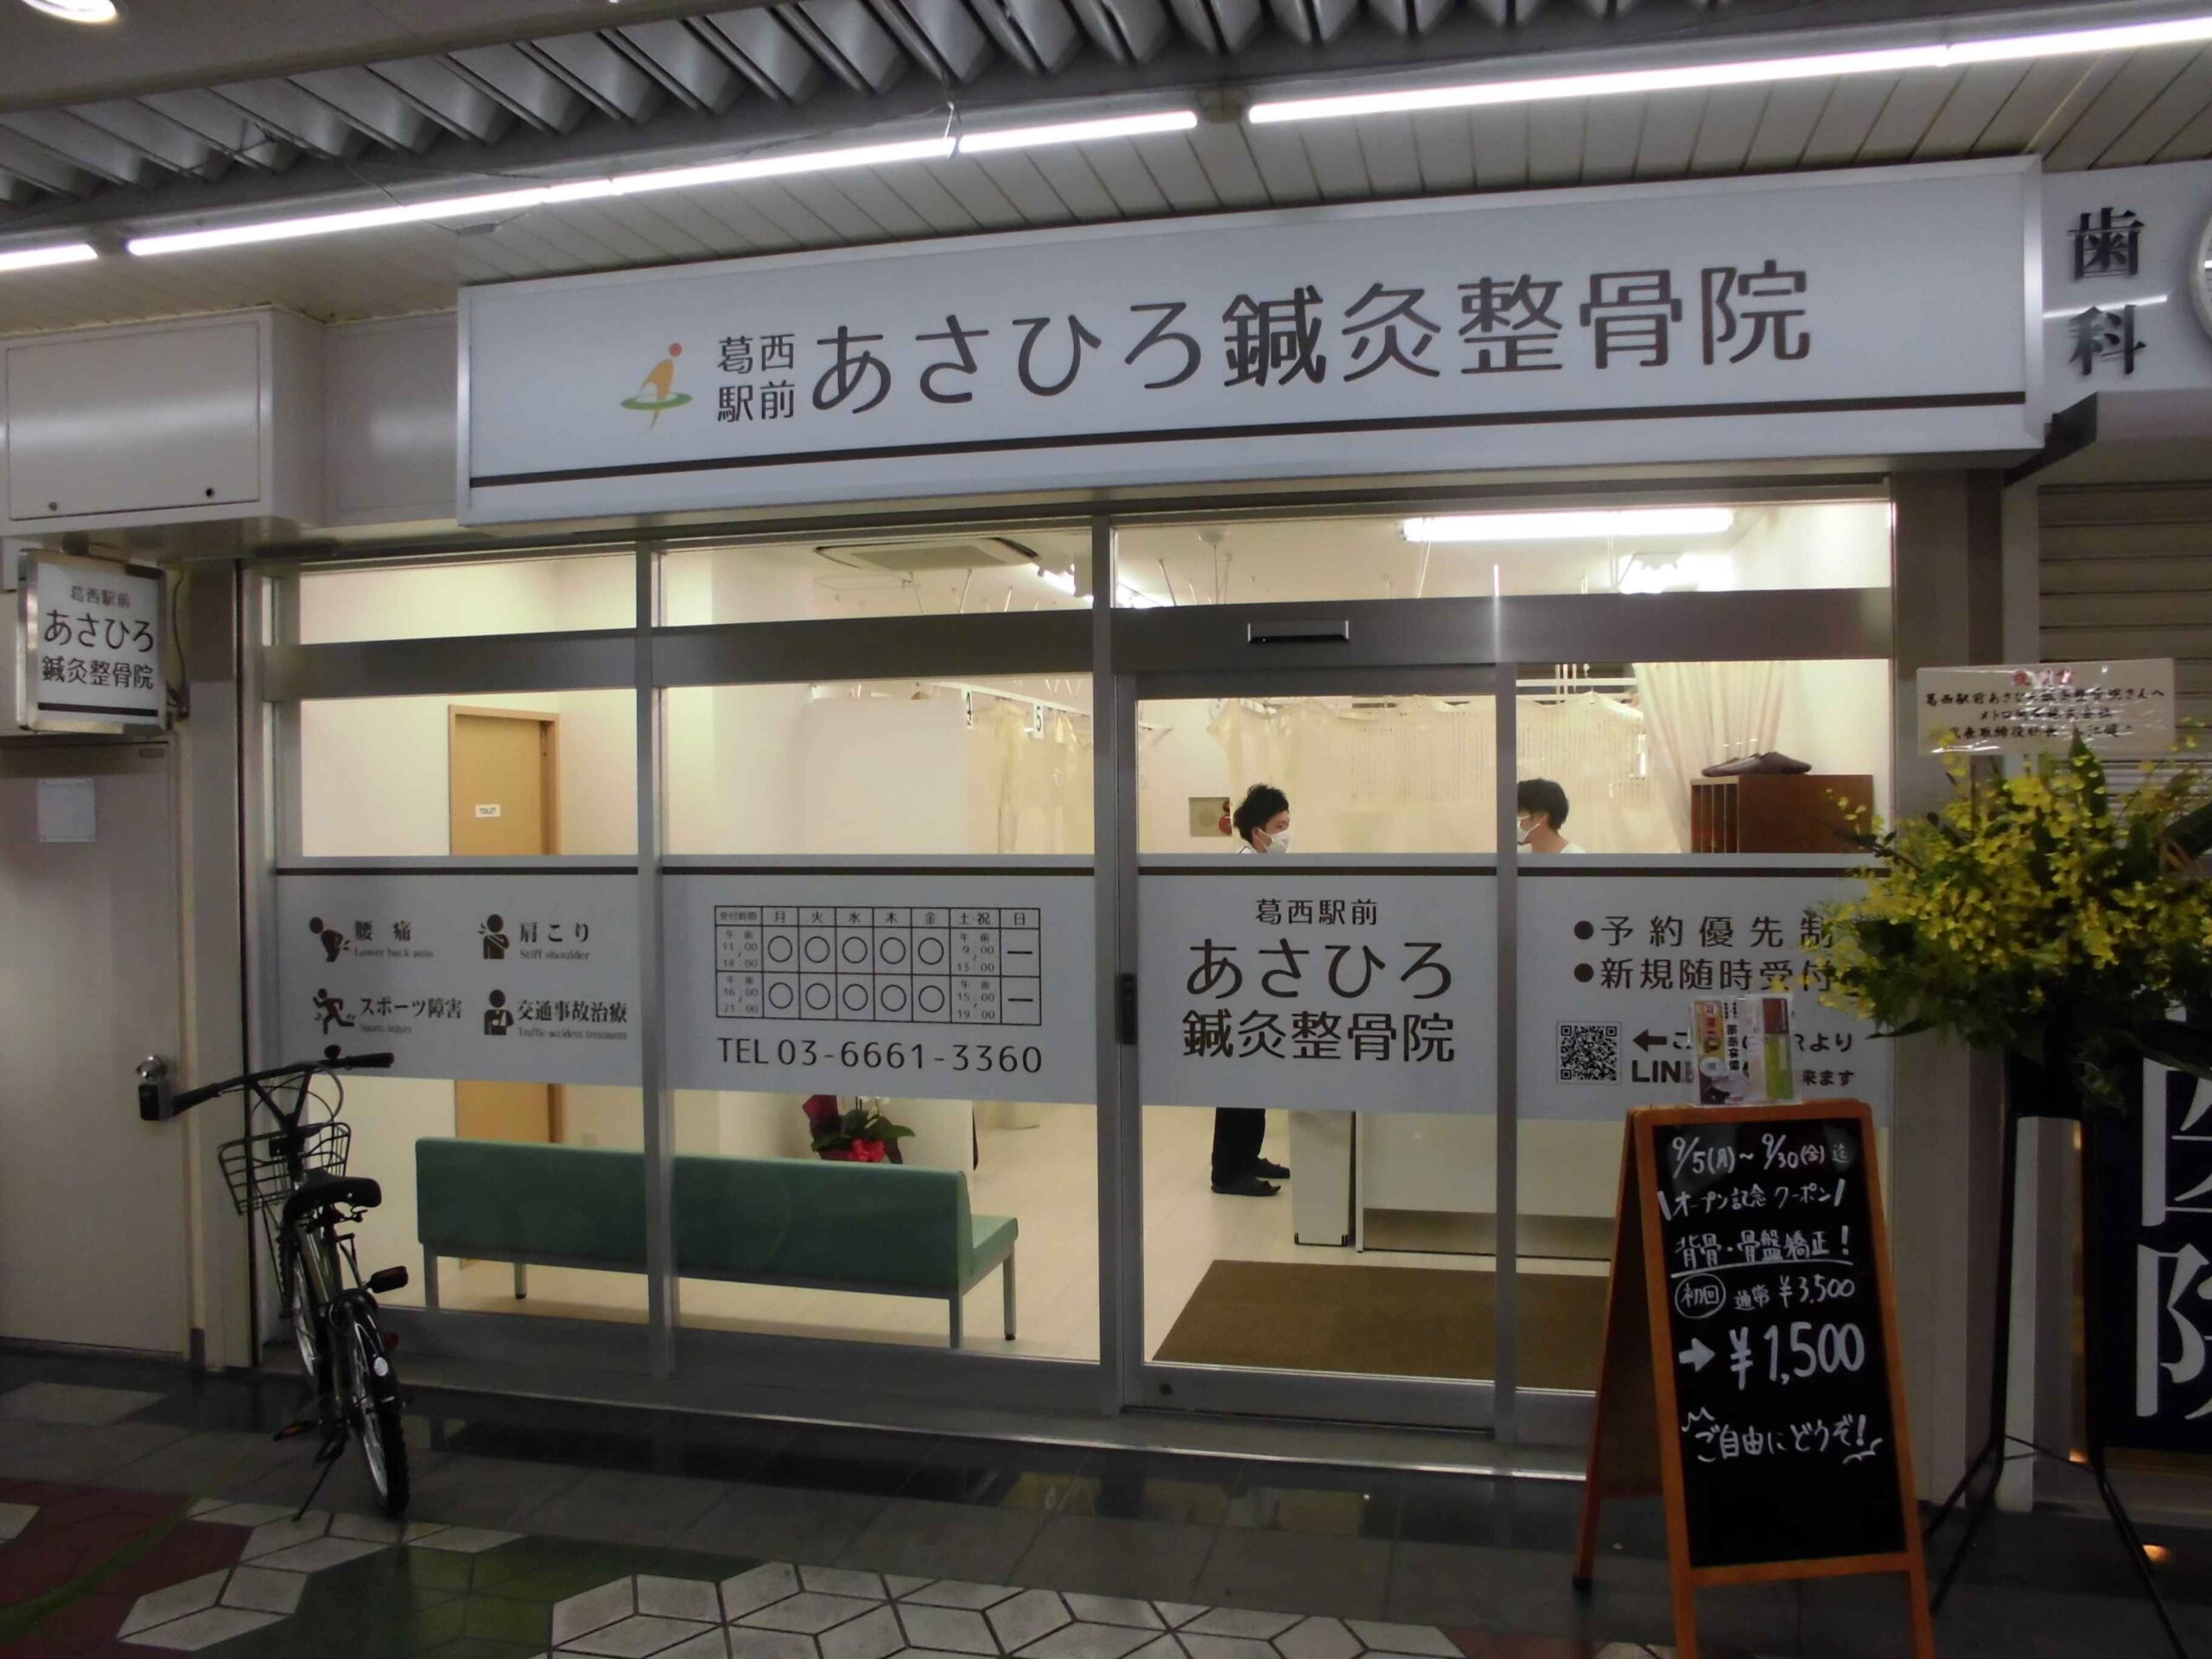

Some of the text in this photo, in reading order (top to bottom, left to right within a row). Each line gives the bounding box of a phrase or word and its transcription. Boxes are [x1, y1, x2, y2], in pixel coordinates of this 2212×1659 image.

[811, 260, 1810, 414] あさひろ鍼灸整骨院
[718, 335, 795, 374] 葛西
[718, 381, 795, 423] 駅前
[70, 584, 130, 609] 葛西駅前
[43, 608, 154, 653] あさひろ
[41, 655, 154, 690] 鍼灸整骨院
[774, 911, 786, 924] 月
[811, 912, 823, 925] 火
[849, 912, 861, 925] 水
[885, 912, 898, 925] 木
[925, 912, 938, 925] 金
[1014, 912, 1026, 926] 日
[1255, 899, 1378, 925] 葛西駅前
[354, 919, 411, 943] 腰痛
[519, 921, 589, 943] 肩こり
[519, 949, 590, 960] Stiff shoulder
[1186, 938, 1452, 999] あさひろ
[360, 995, 463, 1020] スポーツ障害
[518, 999, 628, 1023] 交通事故治療
[1182, 1008, 1455, 1062] 鍼灸整骨院
[1681, 1282, 1719, 1309] 初回
